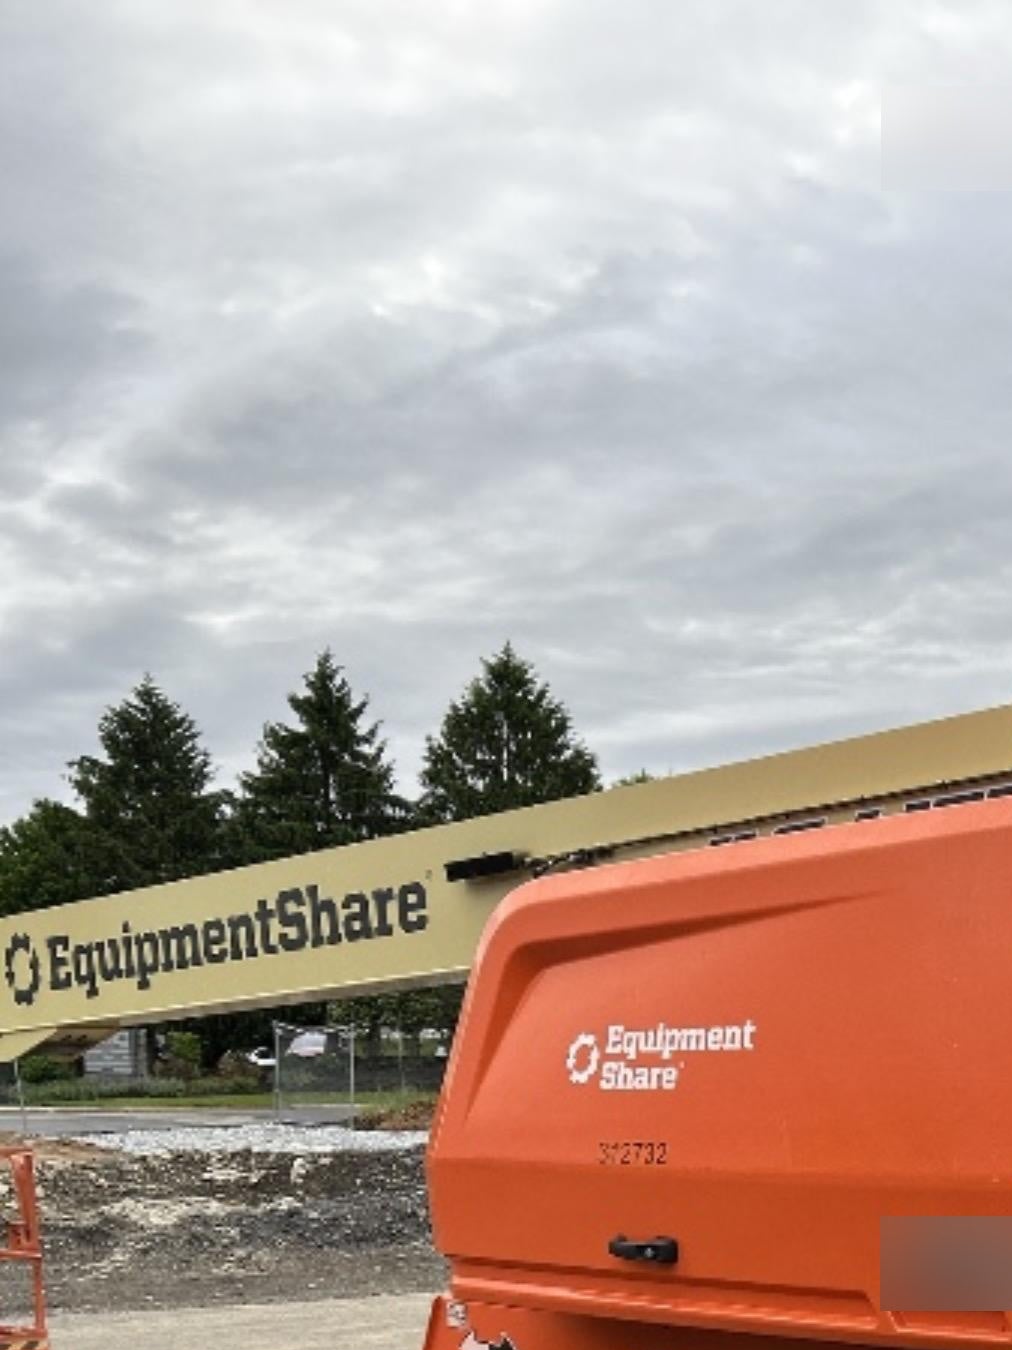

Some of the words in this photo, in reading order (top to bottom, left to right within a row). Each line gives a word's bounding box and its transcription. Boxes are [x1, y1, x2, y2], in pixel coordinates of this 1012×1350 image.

[46, 881, 428, 998] EquipmentShare
[605, 1020, 756, 1059] Equipment
[600, 1062, 678, 1090] Share
